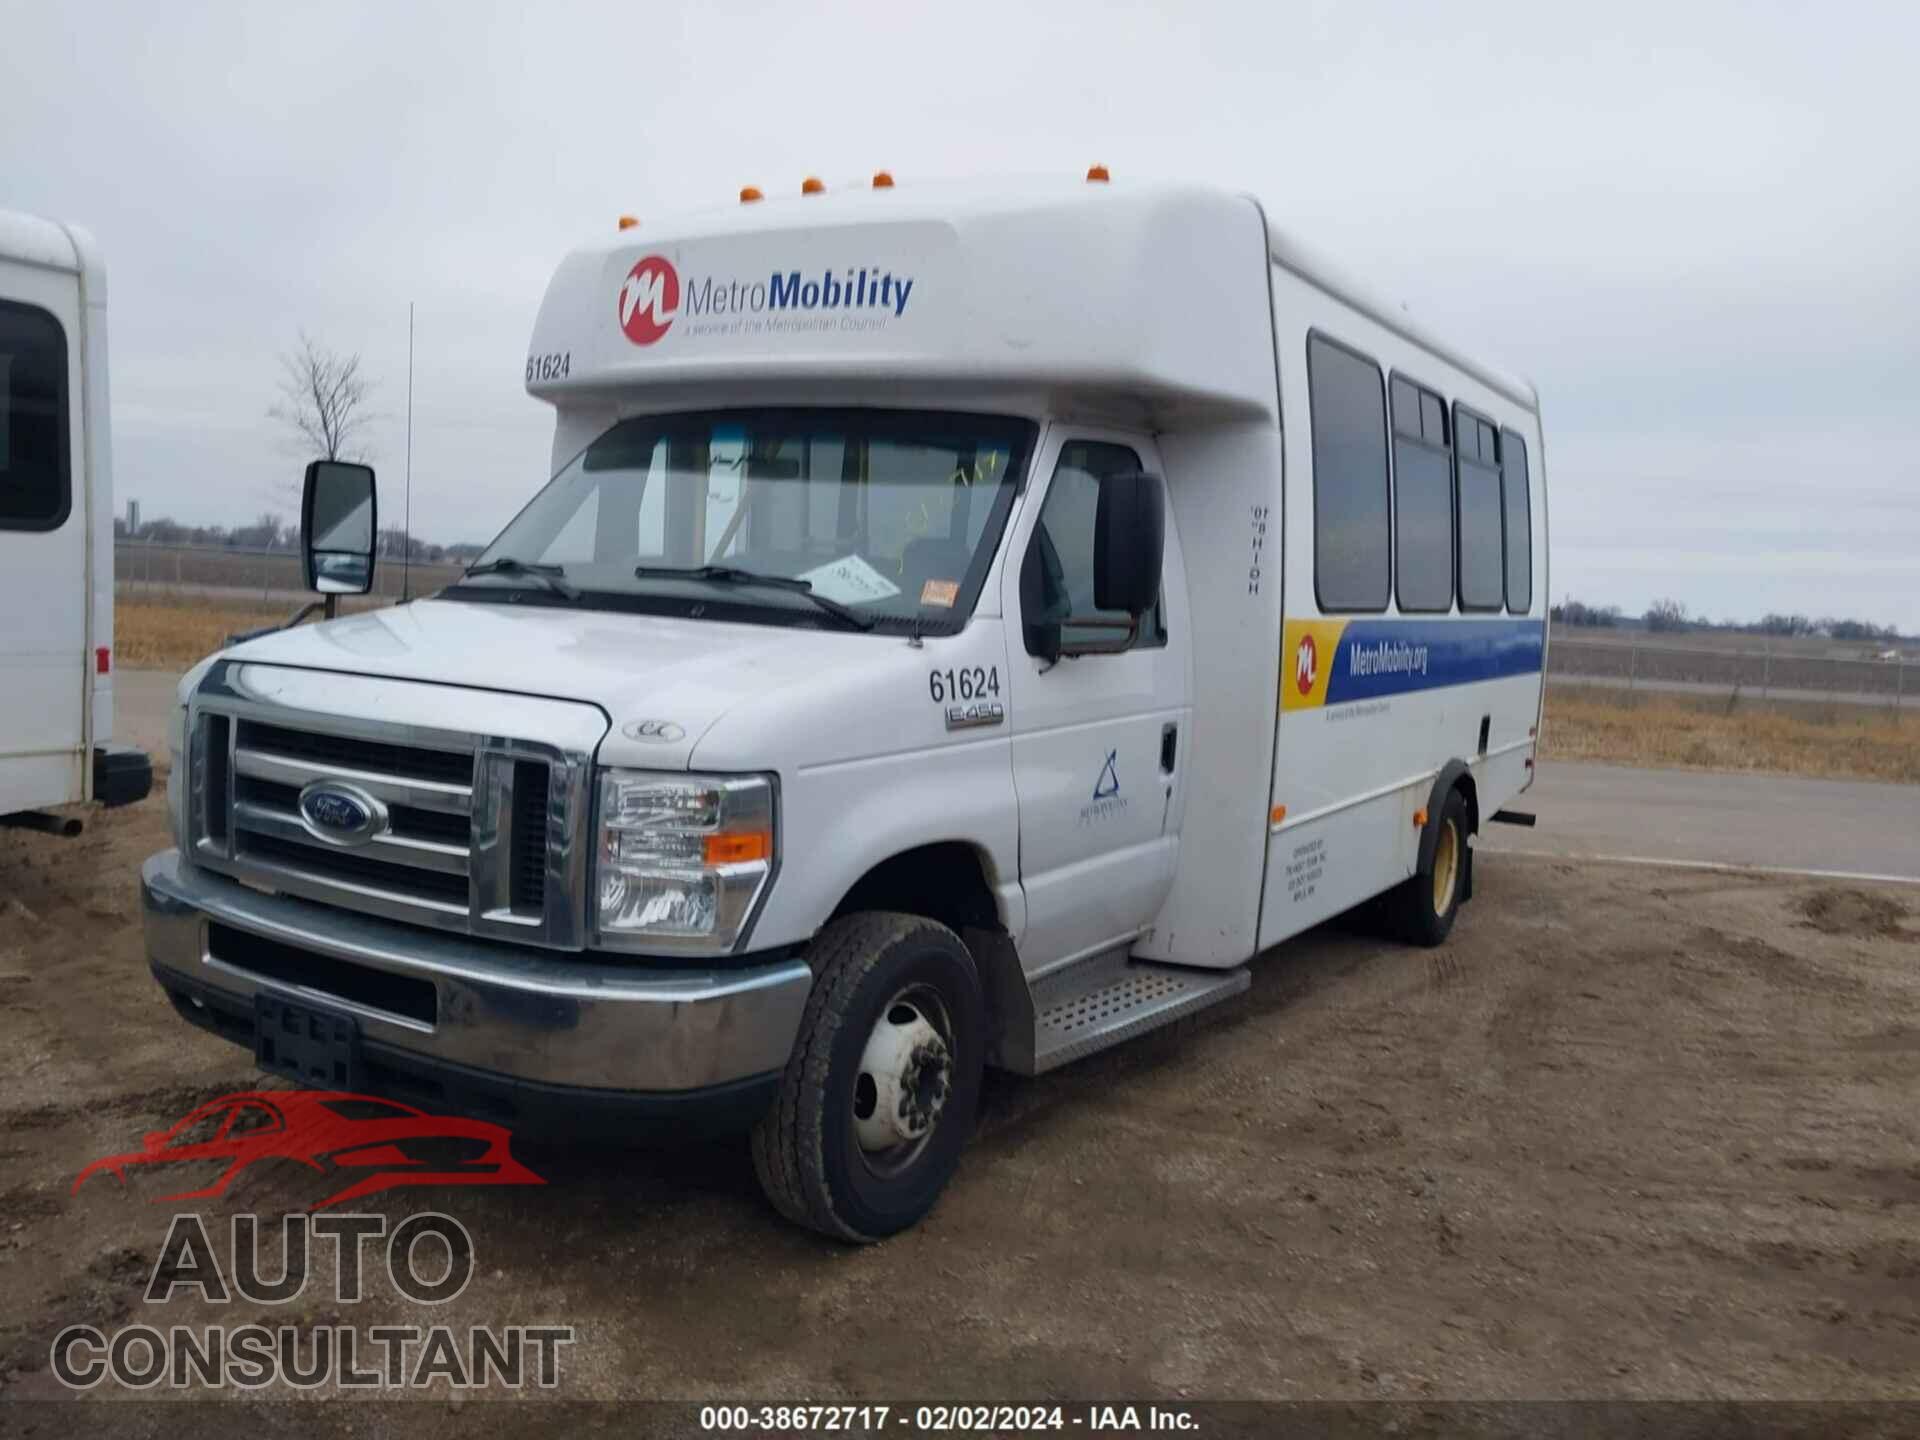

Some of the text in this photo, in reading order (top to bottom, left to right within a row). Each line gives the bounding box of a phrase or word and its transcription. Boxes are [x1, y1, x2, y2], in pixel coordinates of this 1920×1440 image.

[685, 268, 913, 317] MetroMobility
[745, 319, 761, 332] the
[766, 317, 837, 334] Metropolitan
[840, 316, 887, 331] Council
[526, 352, 571, 383] 61624
[1349, 638, 1428, 677] MetroMobility.org
[929, 666, 1000, 702] 61624
